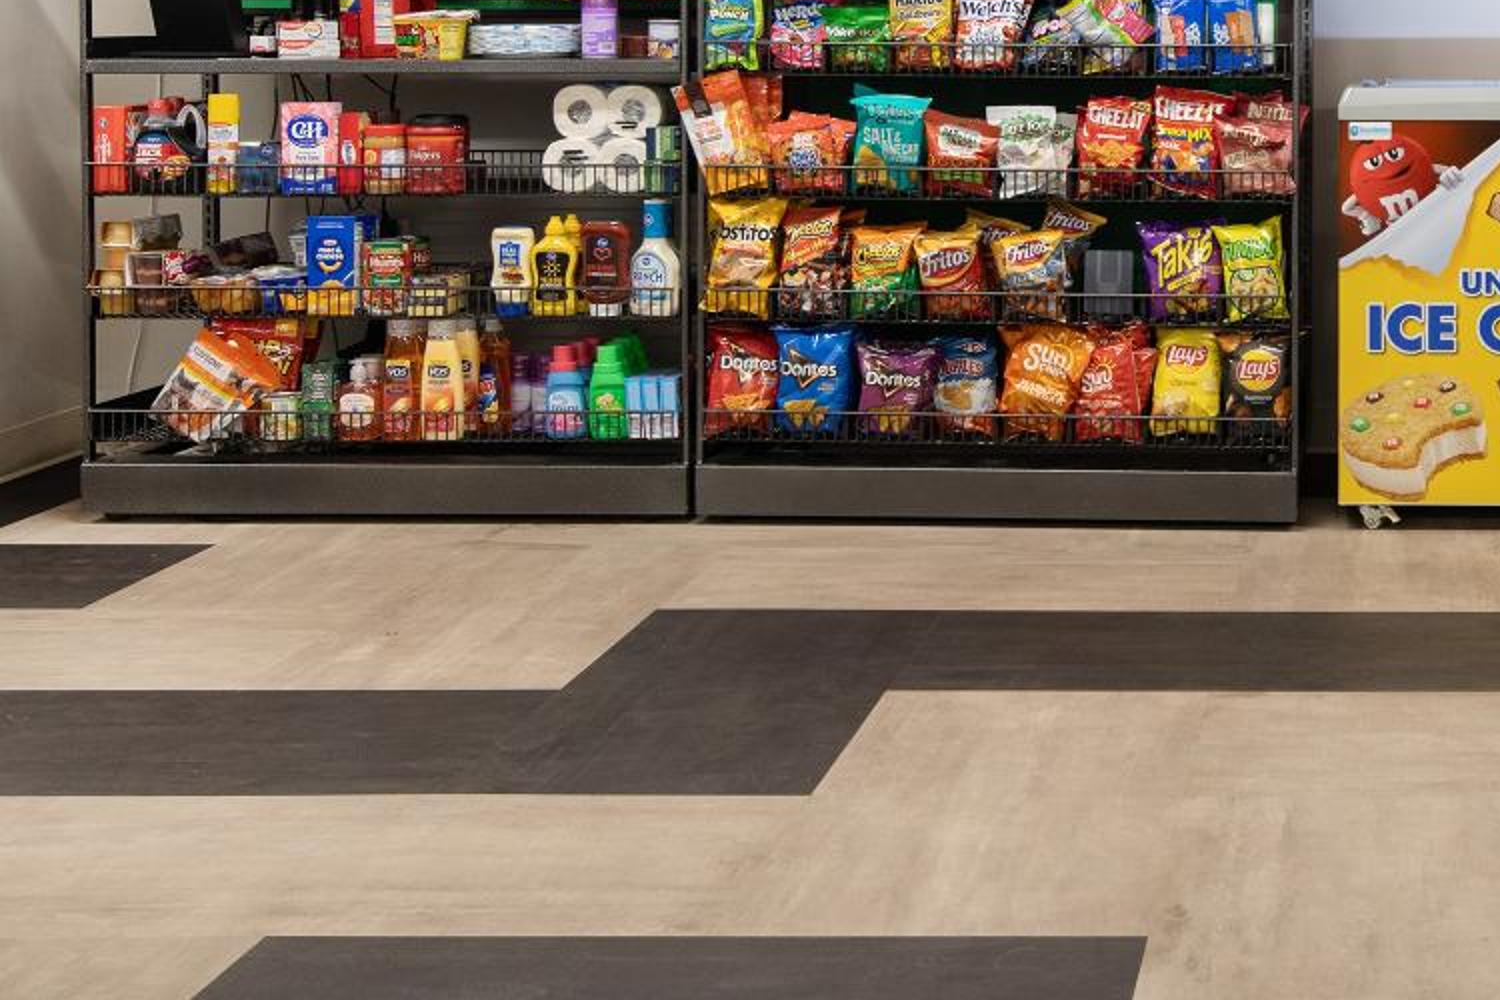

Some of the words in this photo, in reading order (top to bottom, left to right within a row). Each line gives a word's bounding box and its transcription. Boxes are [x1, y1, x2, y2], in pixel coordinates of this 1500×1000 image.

[961, 0, 1024, 17] Welch's
[291, 120, 324, 140] C&H
[863, 126, 895, 145] SALT
[1187, 127, 1213, 141] MIX
[711, 224, 778, 242] OSTITOS
[919, 249, 971, 278] Fritos
[1151, 229, 1213, 289] Takis
[1366, 304, 1458, 355] ICE
[720, 354, 778, 373] Doritos
[1024, 343, 1068, 372] Sun
[781, 360, 837, 377] Doritos
[865, 370, 921, 388] Doritos
